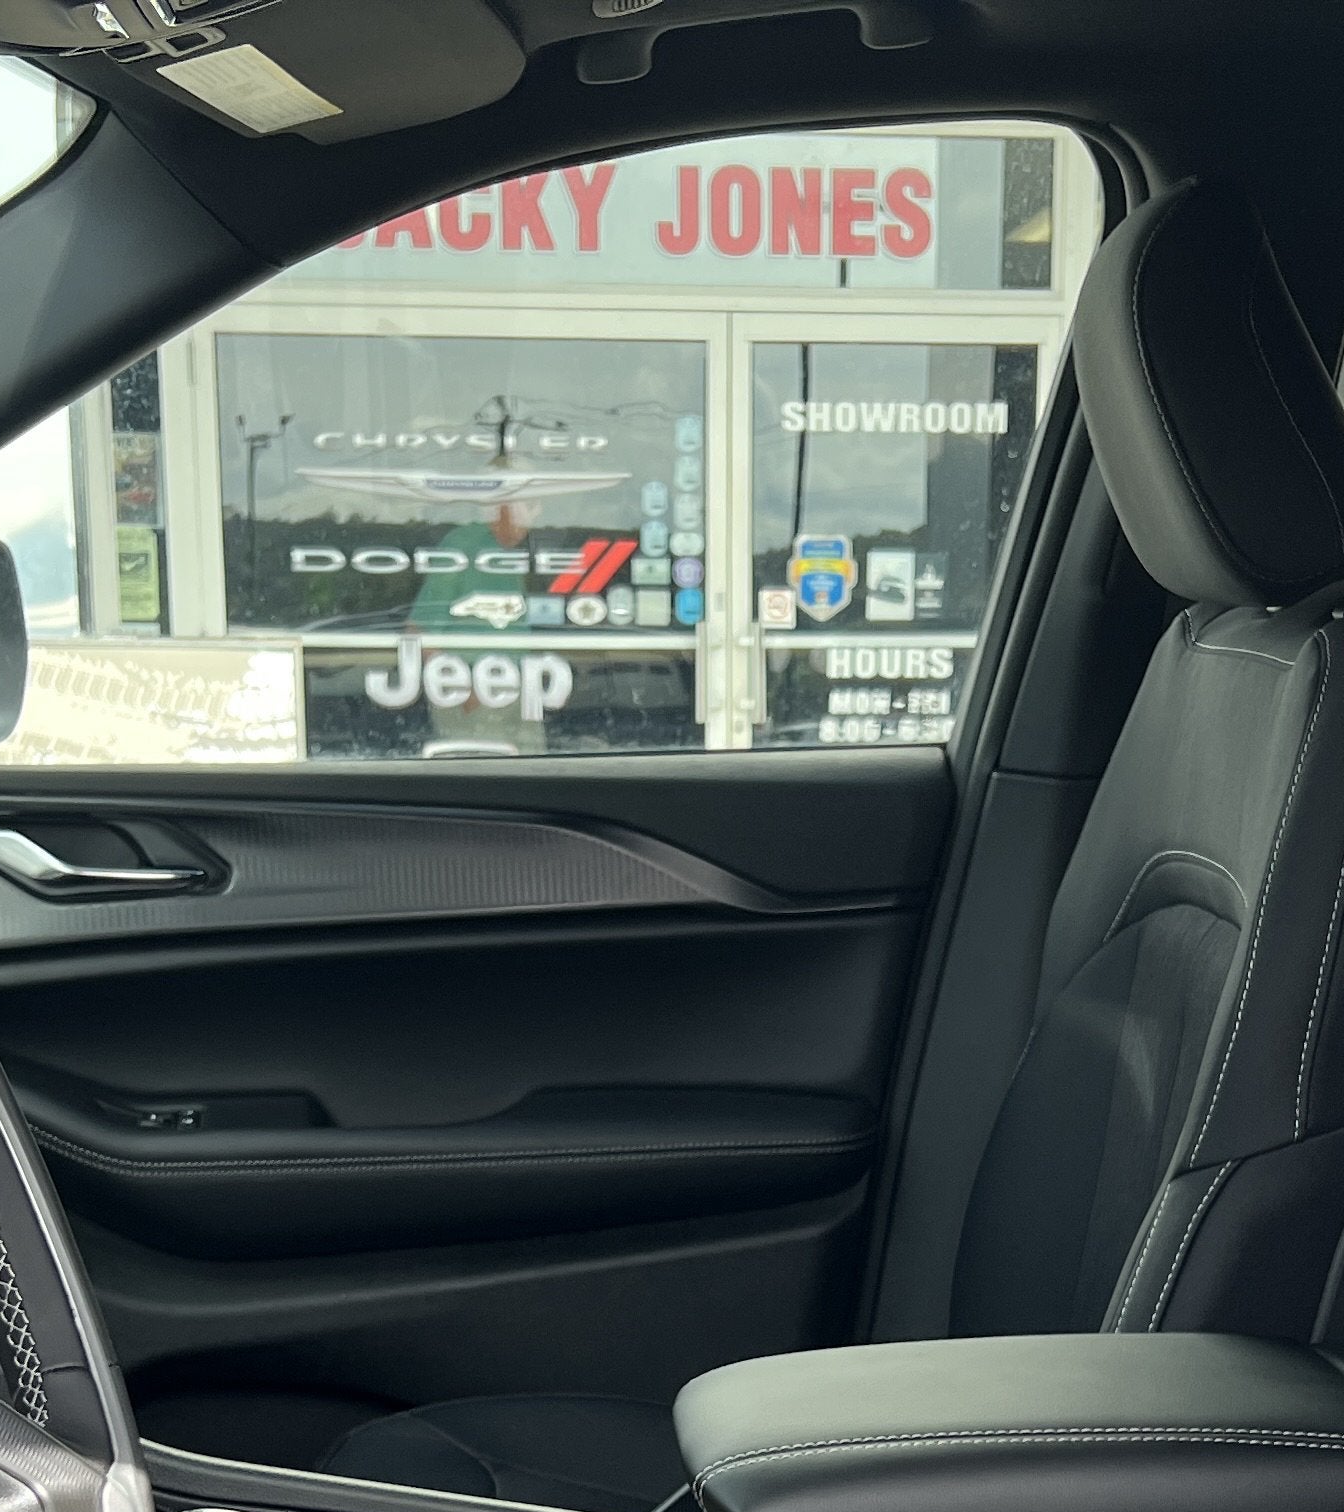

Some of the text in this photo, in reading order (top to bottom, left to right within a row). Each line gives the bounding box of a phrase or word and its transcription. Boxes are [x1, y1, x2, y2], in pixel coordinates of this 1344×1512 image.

[336, 162, 933, 258] ACKY JONES
[781, 402, 1008, 434] SHOWROOM
[290, 547, 586, 576] DODGE
[365, 637, 573, 721] Jeep
[826, 648, 954, 679] HOURS
